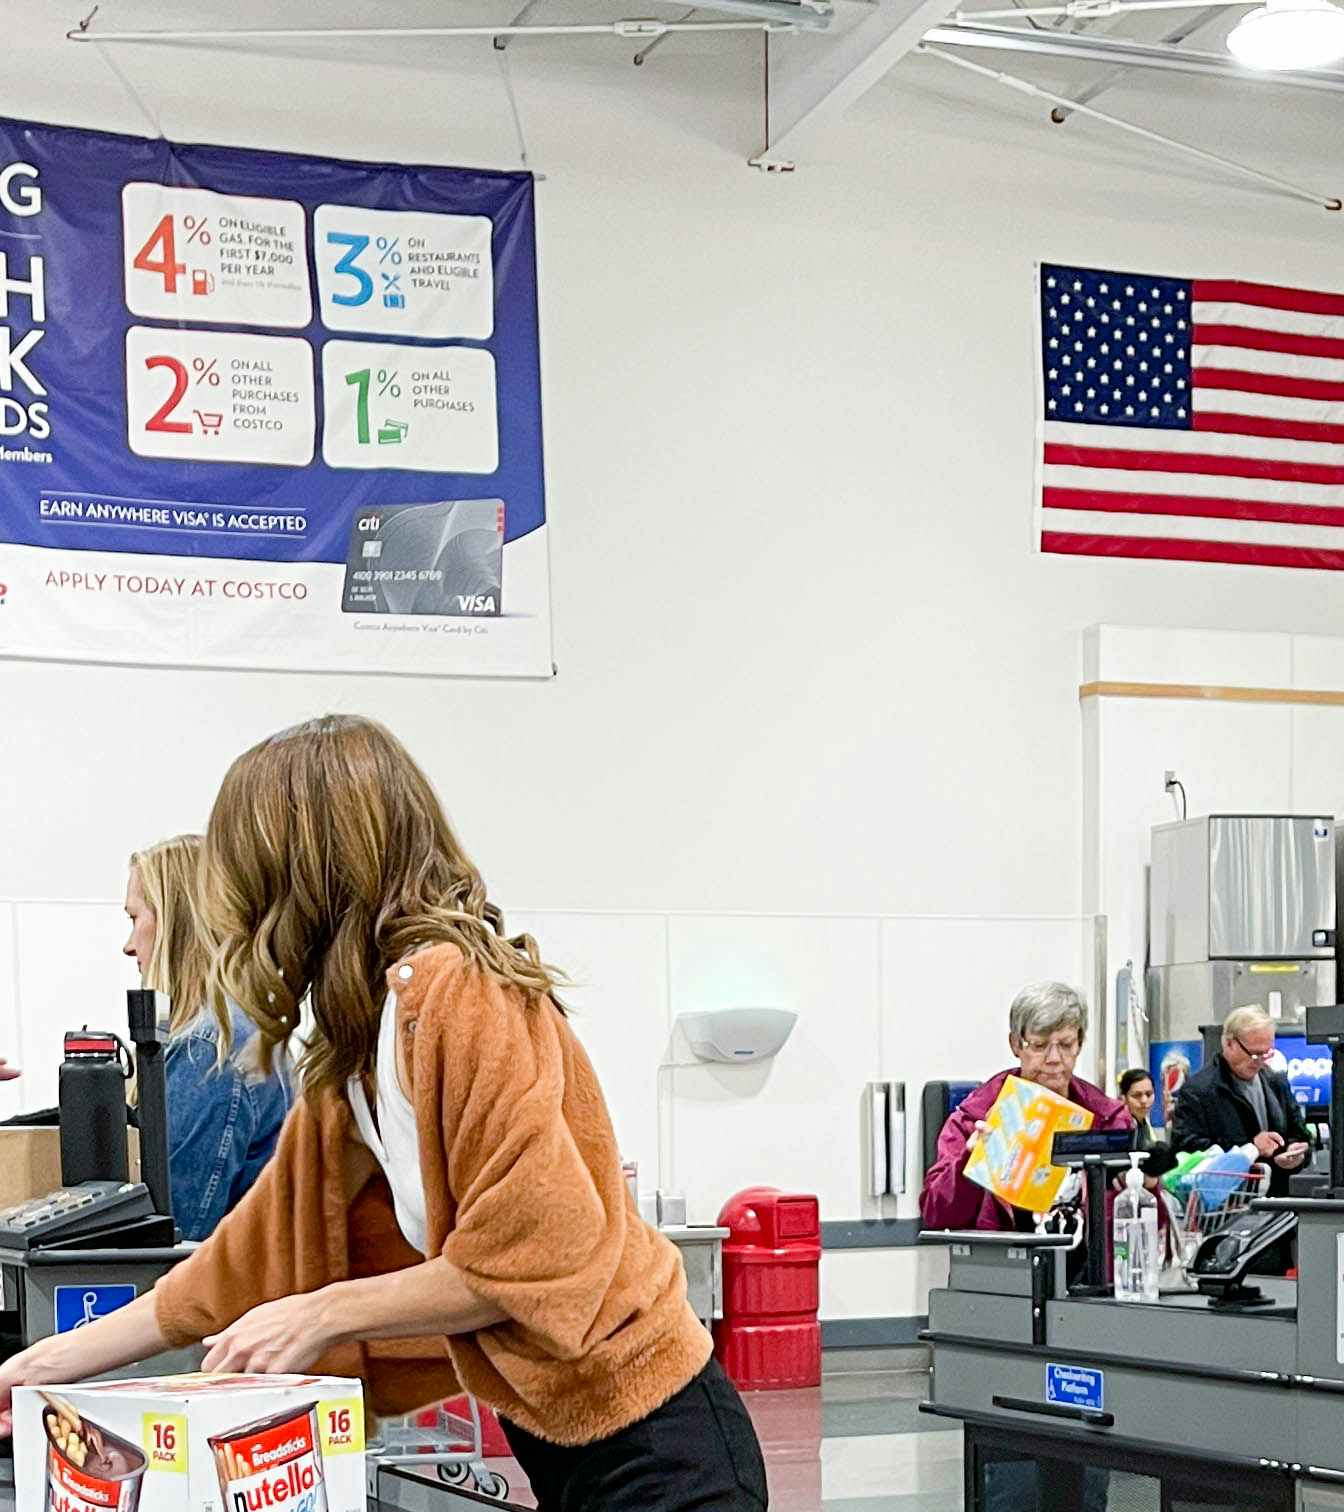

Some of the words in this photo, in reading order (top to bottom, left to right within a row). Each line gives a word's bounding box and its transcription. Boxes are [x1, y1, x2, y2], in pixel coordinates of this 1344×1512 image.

[219, 217, 237, 228] ON
[240, 219, 286, 236] ELIGIBLE
[248, 235, 271, 248] FOR
[273, 239, 294, 251] THE
[408, 237, 425, 248] ON
[220, 249, 250, 260] FIRST
[408, 252, 481, 264] RESTAURANTS
[220, 262, 241, 273] PER
[245, 263, 275, 275] YEAR
[410, 265, 434, 275] AND
[438, 265, 480, 279] ELIGIBLE
[412, 278, 451, 291] TRAVEL
[231, 359, 249, 370] ON
[253, 360, 273, 371] ALL
[232, 374, 272, 385] OTHER
[411, 371, 430, 381] ON
[434, 370, 451, 381] ALL
[232, 389, 299, 403] PURCHASES
[412, 384, 449, 395] OTHER
[232, 404, 266, 415] FROM
[413, 399, 475, 412] PURCHASES
[233, 418, 283, 430] COSTCO
[40, 500, 83, 517] EARN
[86, 502, 169, 525] ANYWHERE
[213, 513, 225, 528] IS
[228, 514, 307, 531] ACCEPTED
[358, 514, 380, 531] citi
[46, 571, 107, 592] APPLY
[113, 575, 186, 596] TODAY
[191, 580, 216, 597] AT
[223, 580, 307, 600] COSTCO
[456, 595, 496, 612] VISA
[1288, 1058, 1333, 1080] pep
[328, 1408, 351, 1434] 16
[153, 1423, 175, 1450] 16
[328, 1434, 352, 1446] PACK
[153, 1451, 176, 1463] PACK
[252, 1436, 306, 1467] Breadsticks
